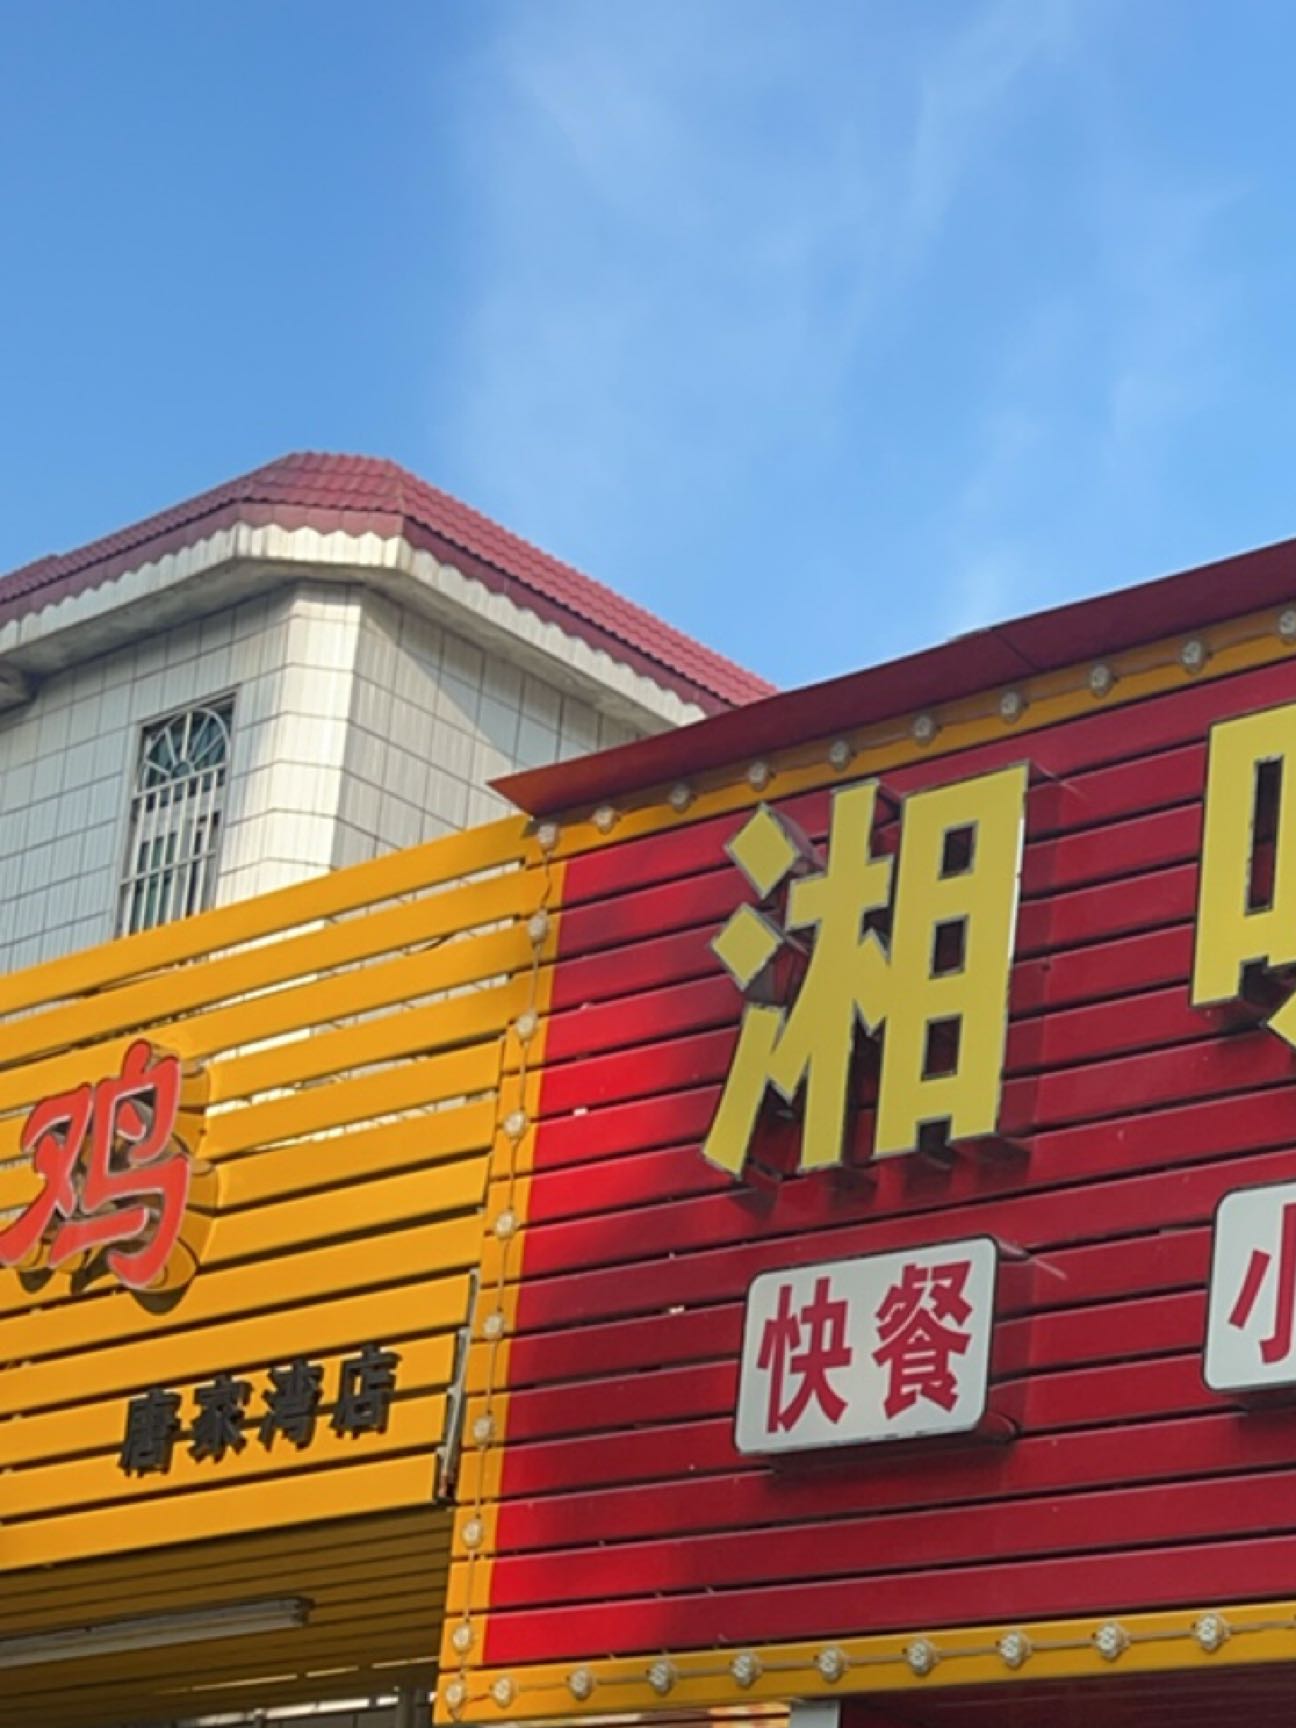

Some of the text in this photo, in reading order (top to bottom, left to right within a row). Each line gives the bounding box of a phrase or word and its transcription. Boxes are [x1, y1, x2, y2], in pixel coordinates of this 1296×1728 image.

[0, 1038, 191, 1288] 鸡
[118, 1344, 404, 1477] 唐家湾店
[758, 1260, 978, 1435] 快餐
